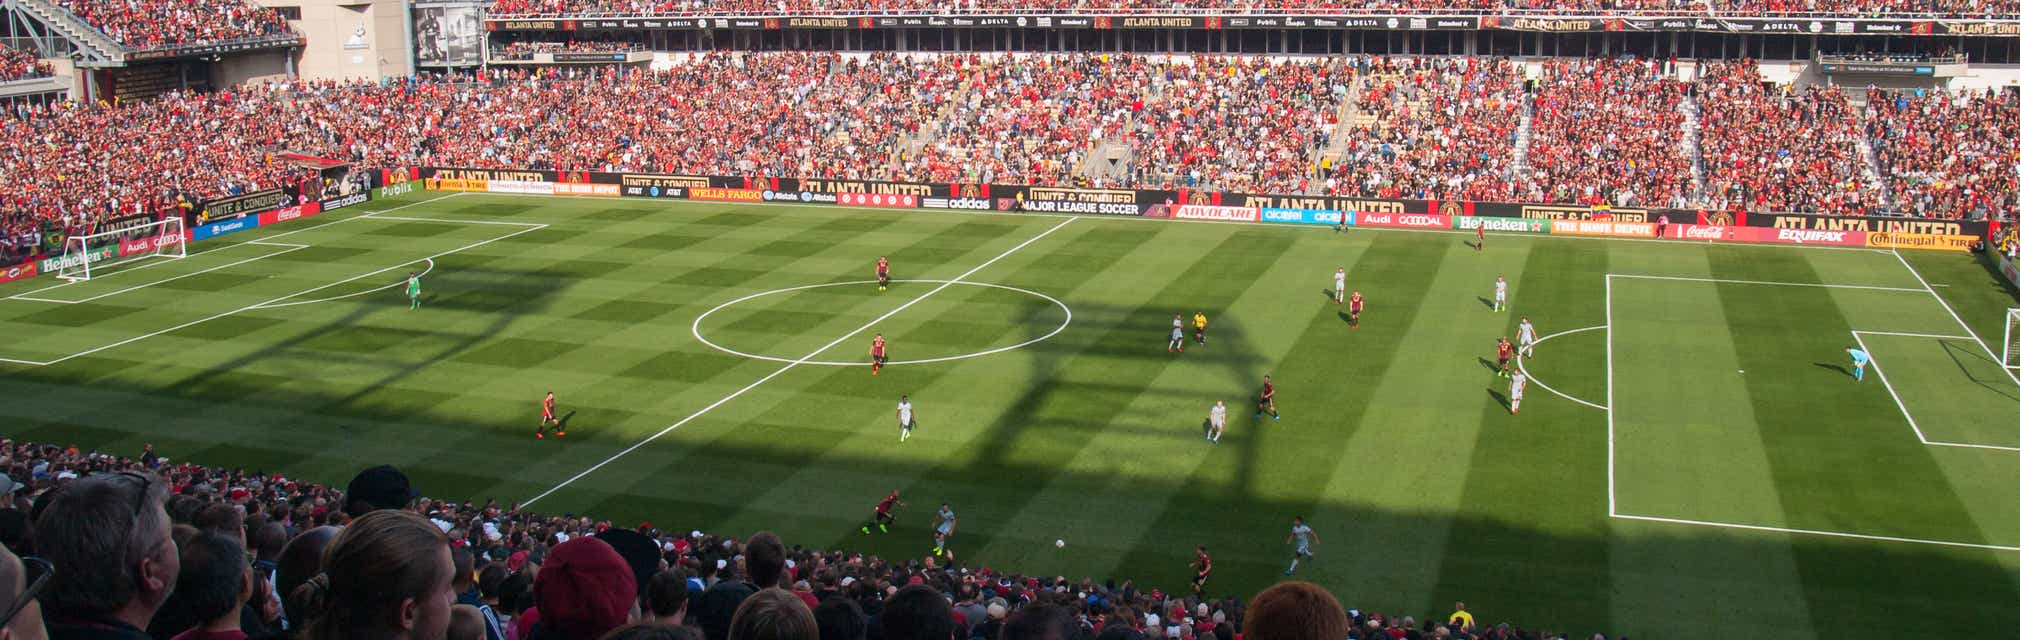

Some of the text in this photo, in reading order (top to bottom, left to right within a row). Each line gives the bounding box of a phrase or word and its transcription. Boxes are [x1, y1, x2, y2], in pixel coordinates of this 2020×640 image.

[532, 21, 555, 29] UNITED
[790, 19, 848, 27] ATLANTA UNITED
[1124, 18, 1192, 27] ATLANTA UNITED
[1556, 20, 1590, 30] UNITED
[494, 171, 544, 183] UNITED
[626, 179, 650, 187] UNITE
[382, 182, 412, 197] Publix
[666, 188, 682, 196] AT&T
[690, 189, 761, 200] WELLS FARGO
[871, 184, 932, 197] UNITED
[341, 193, 367, 207] adidas
[774, 192, 798, 201] Allstate
[812, 193, 837, 202] Allstate
[1033, 191, 1132, 203] UNITE & CONQUER
[209, 193, 281, 217] UNITE & CONQUER
[949, 197, 990, 210] adidas
[1022, 200, 1139, 215] MAJOR LEAGUE SOCCER
[1245, 197, 1405, 214] ATLANTA UNITED
[1180, 206, 1255, 219] ADVOCARE
[1314, 212, 1352, 222] alcatl
[1528, 211, 1643, 223] UNITE & CQUER
[1364, 214, 1391, 224] Audi
[1554, 221, 1578, 232] THE
[1774, 216, 1961, 235] ATLANTA UNITED
[1686, 225, 1723, 239] Coca-Cola
[1778, 229, 1847, 243] EQUIFAX
[127, 241, 148, 252] Audi
[1949, 238, 1974, 248] TIR
